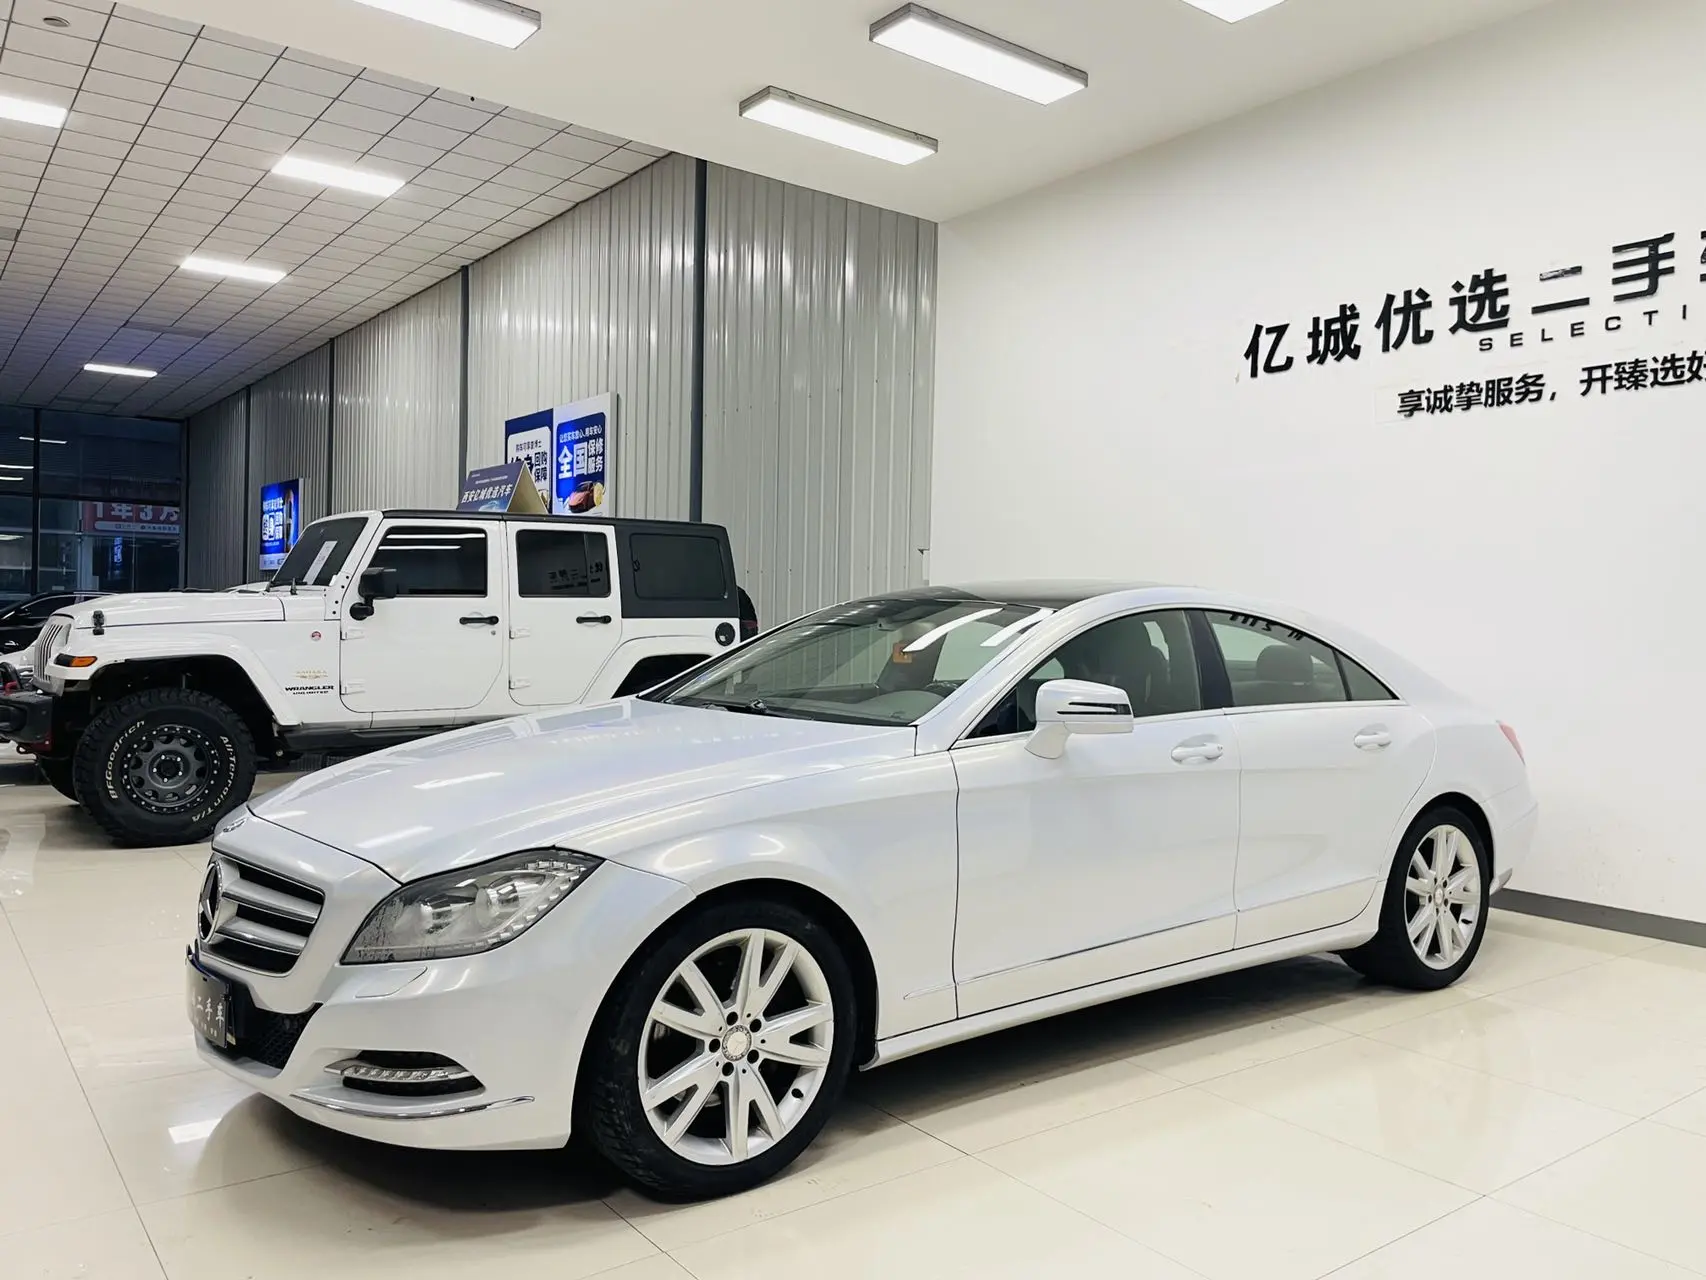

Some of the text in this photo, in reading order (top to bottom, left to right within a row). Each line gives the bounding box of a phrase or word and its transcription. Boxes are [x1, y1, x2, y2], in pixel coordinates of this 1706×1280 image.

[1243, 230, 1706, 378] 亿城优选二手
[587, 438, 604, 458] 保修
[534, 451, 548, 467] 回购
[558, 442, 588, 480] 全国
[587, 457, 604, 475] 服务
[534, 467, 548, 483] 保障
[104, 720, 145, 799] BFGoodrich
